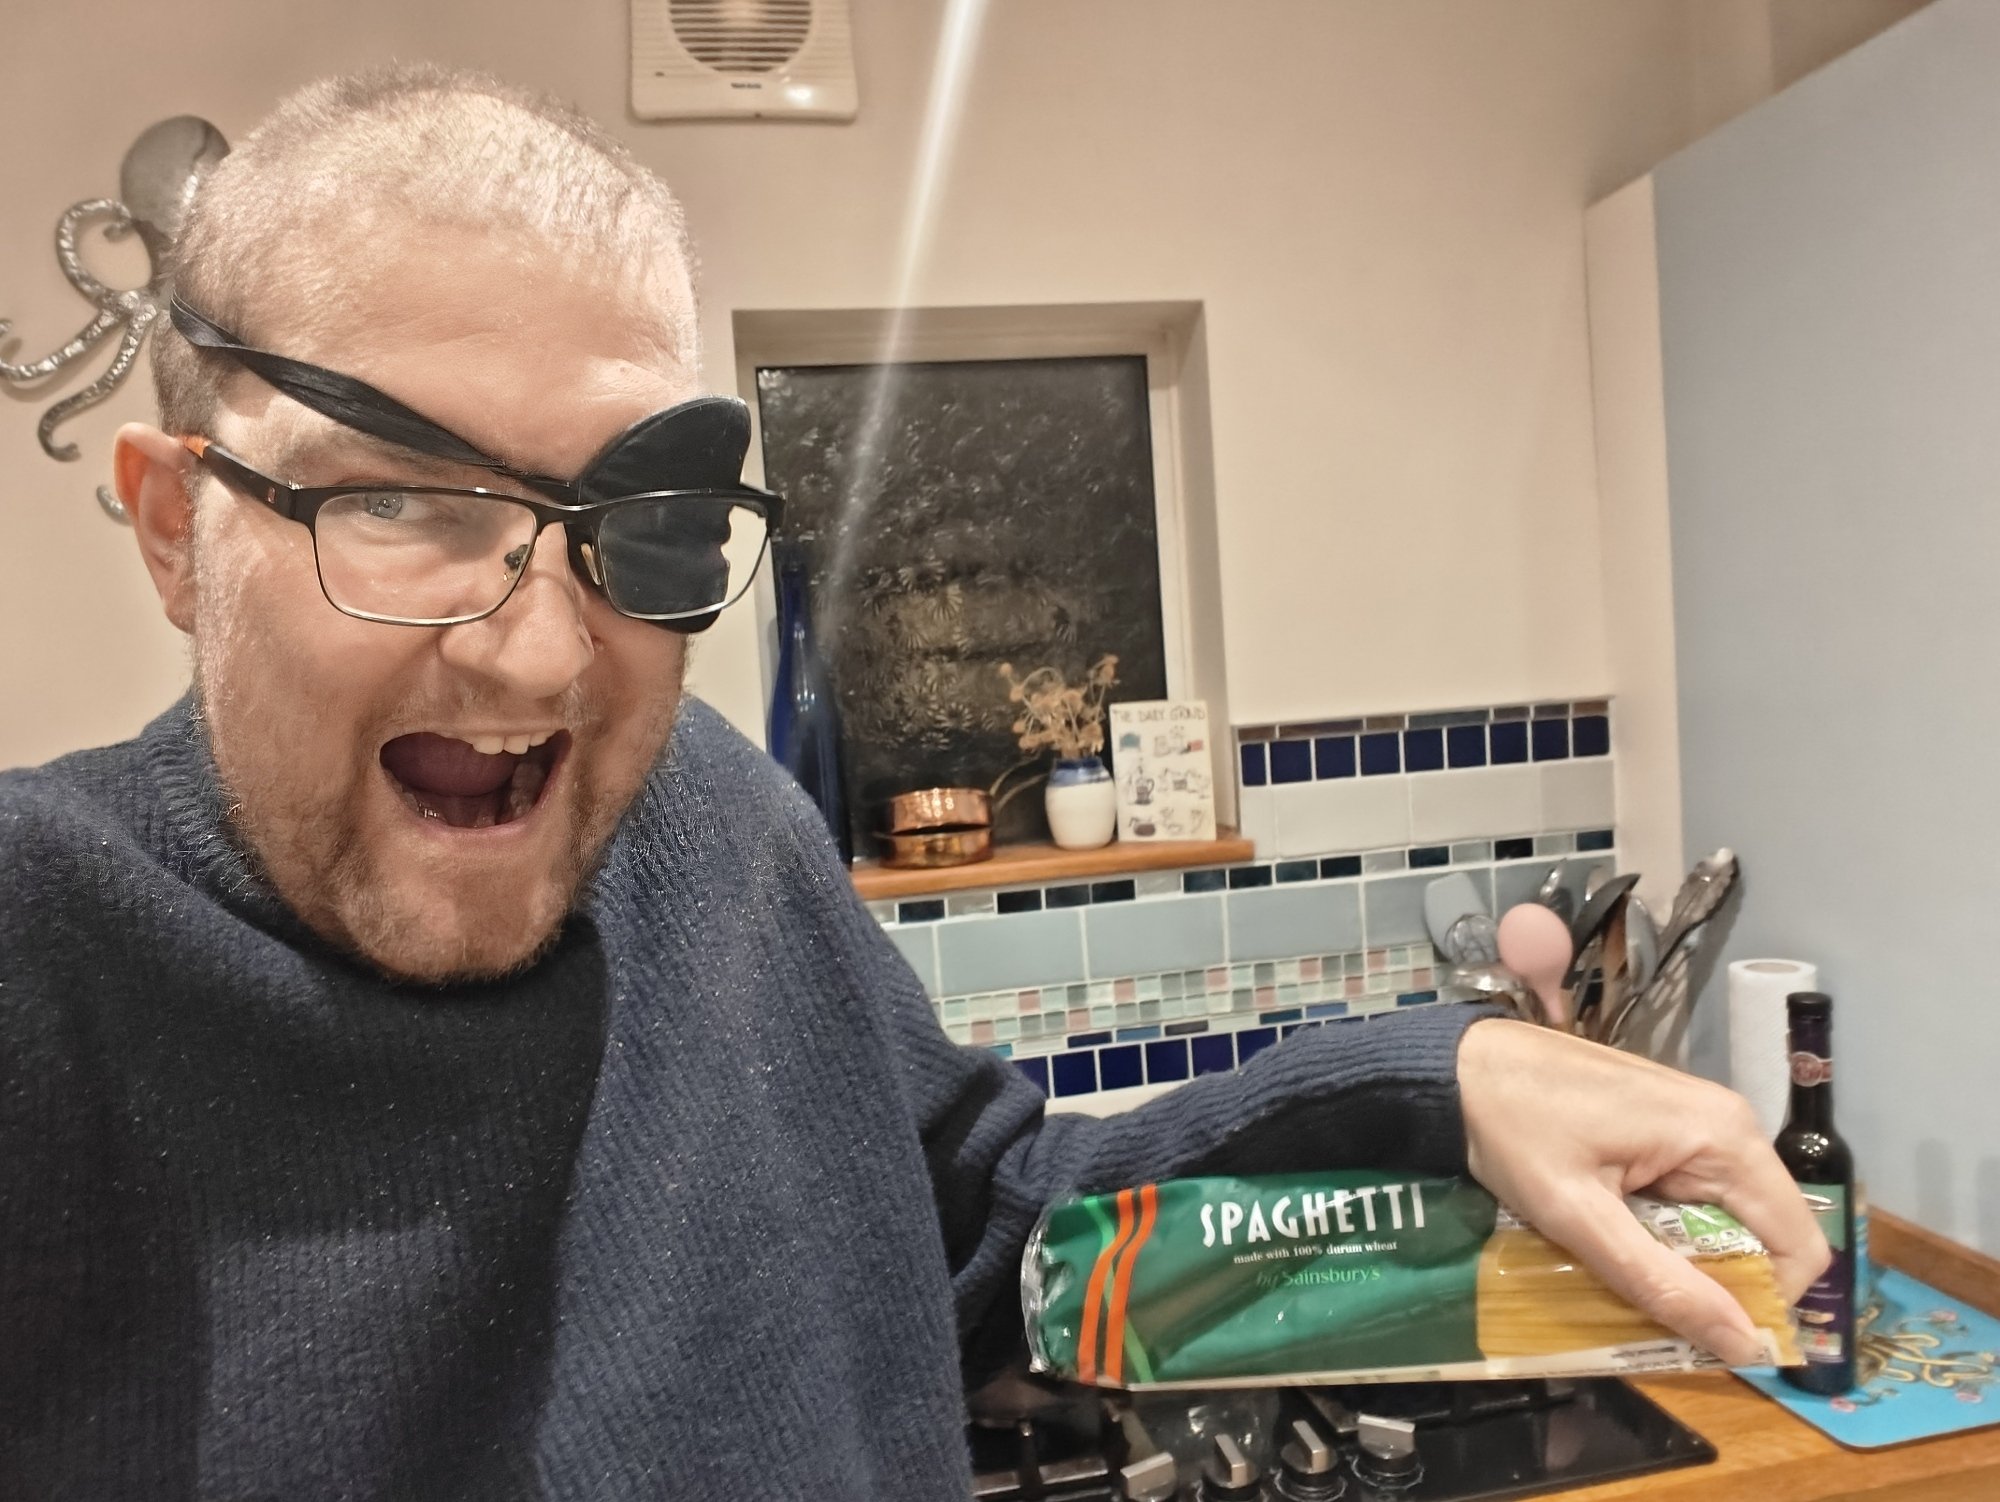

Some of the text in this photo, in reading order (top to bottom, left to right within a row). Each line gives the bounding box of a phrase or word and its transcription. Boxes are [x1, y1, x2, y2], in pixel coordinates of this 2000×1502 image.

[1200, 1182, 1425, 1248] SPAGHETTI
[1234, 1240, 1398, 1265] made with 100% durum wheat
[1256, 1264, 1381, 1289] by Sainsbury's
